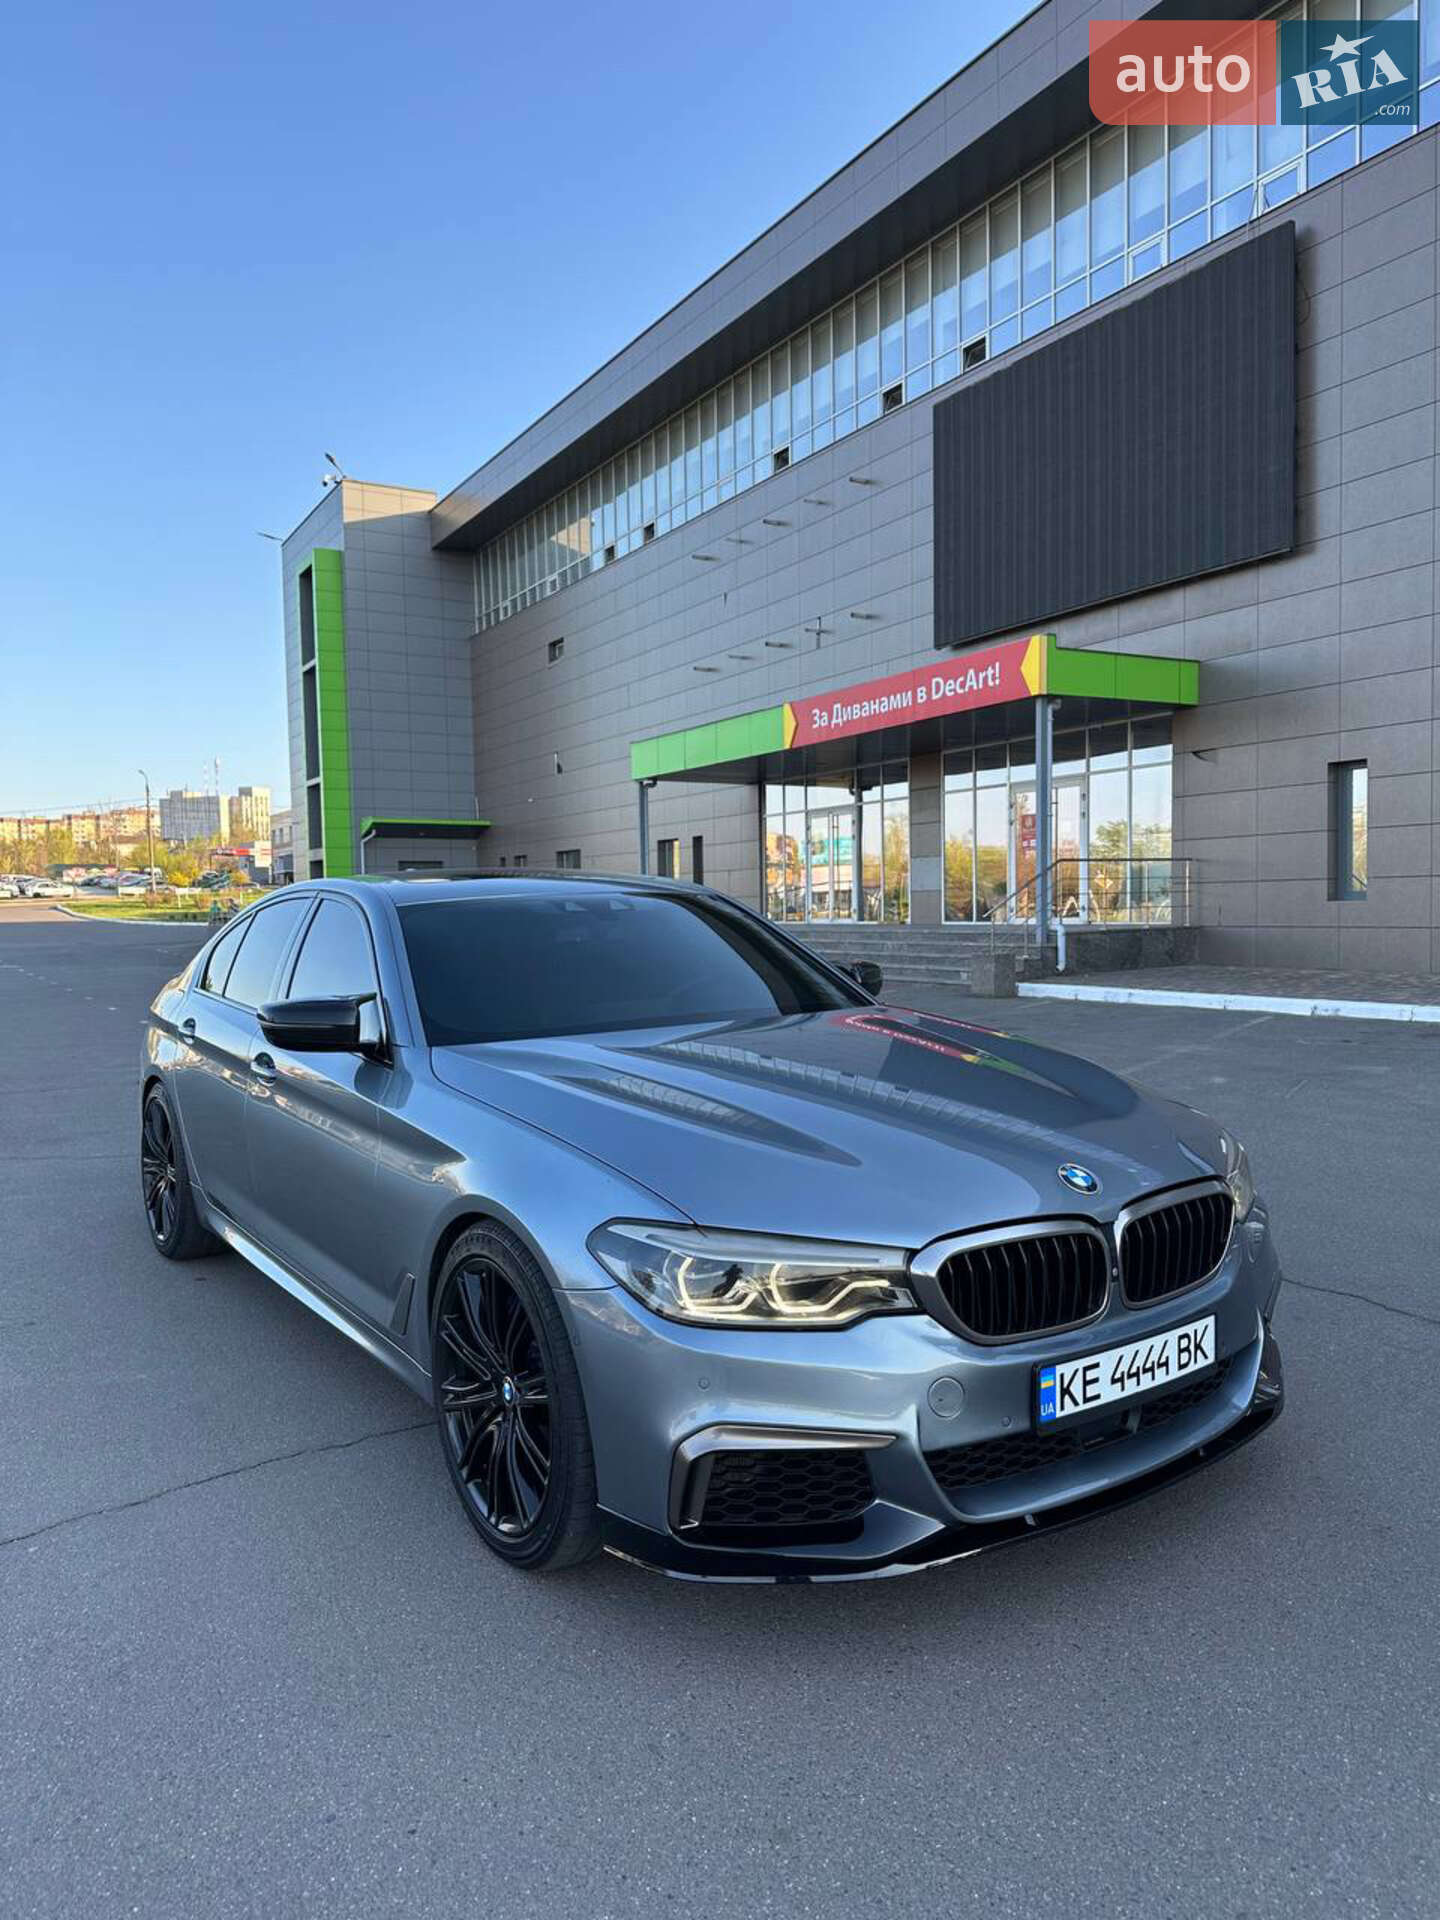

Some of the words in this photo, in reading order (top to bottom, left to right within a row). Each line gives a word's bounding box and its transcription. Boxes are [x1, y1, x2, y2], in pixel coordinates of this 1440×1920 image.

[811, 708, 829, 729] За
[830, 691, 913, 728] Диванами
[916, 686, 928, 704] в
[931, 661, 1001, 700] DecArt!
[1059, 1362, 1101, 1412] KE
[1110, 1339, 1170, 1392] 4444
[1177, 1324, 1210, 1372] BK
[1040, 1403, 1055, 1417] UA
